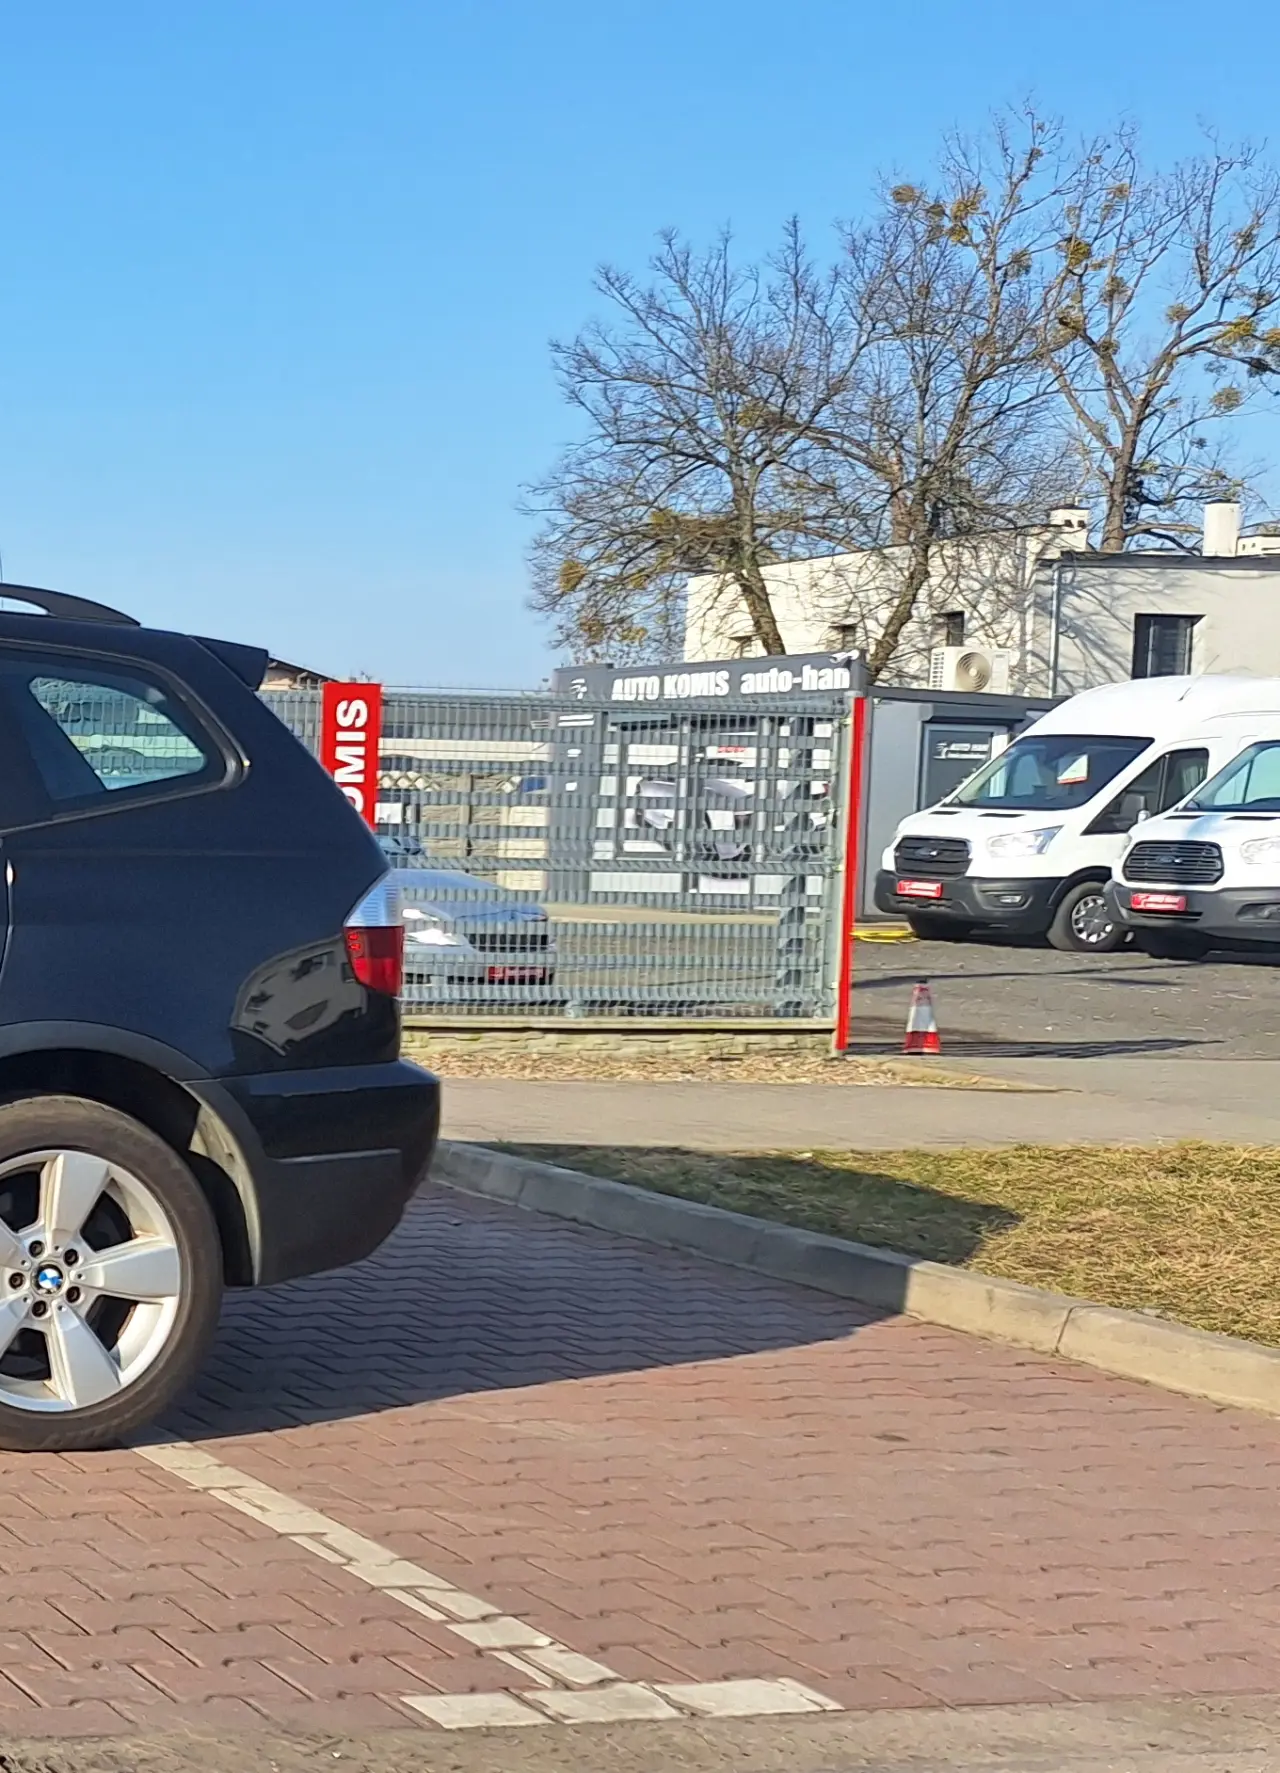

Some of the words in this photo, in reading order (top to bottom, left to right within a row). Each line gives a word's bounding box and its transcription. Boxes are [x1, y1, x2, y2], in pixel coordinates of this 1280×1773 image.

[611, 676, 660, 700] AUTO
[663, 670, 730, 699] KOMIS
[740, 664, 850, 694] auto-han
